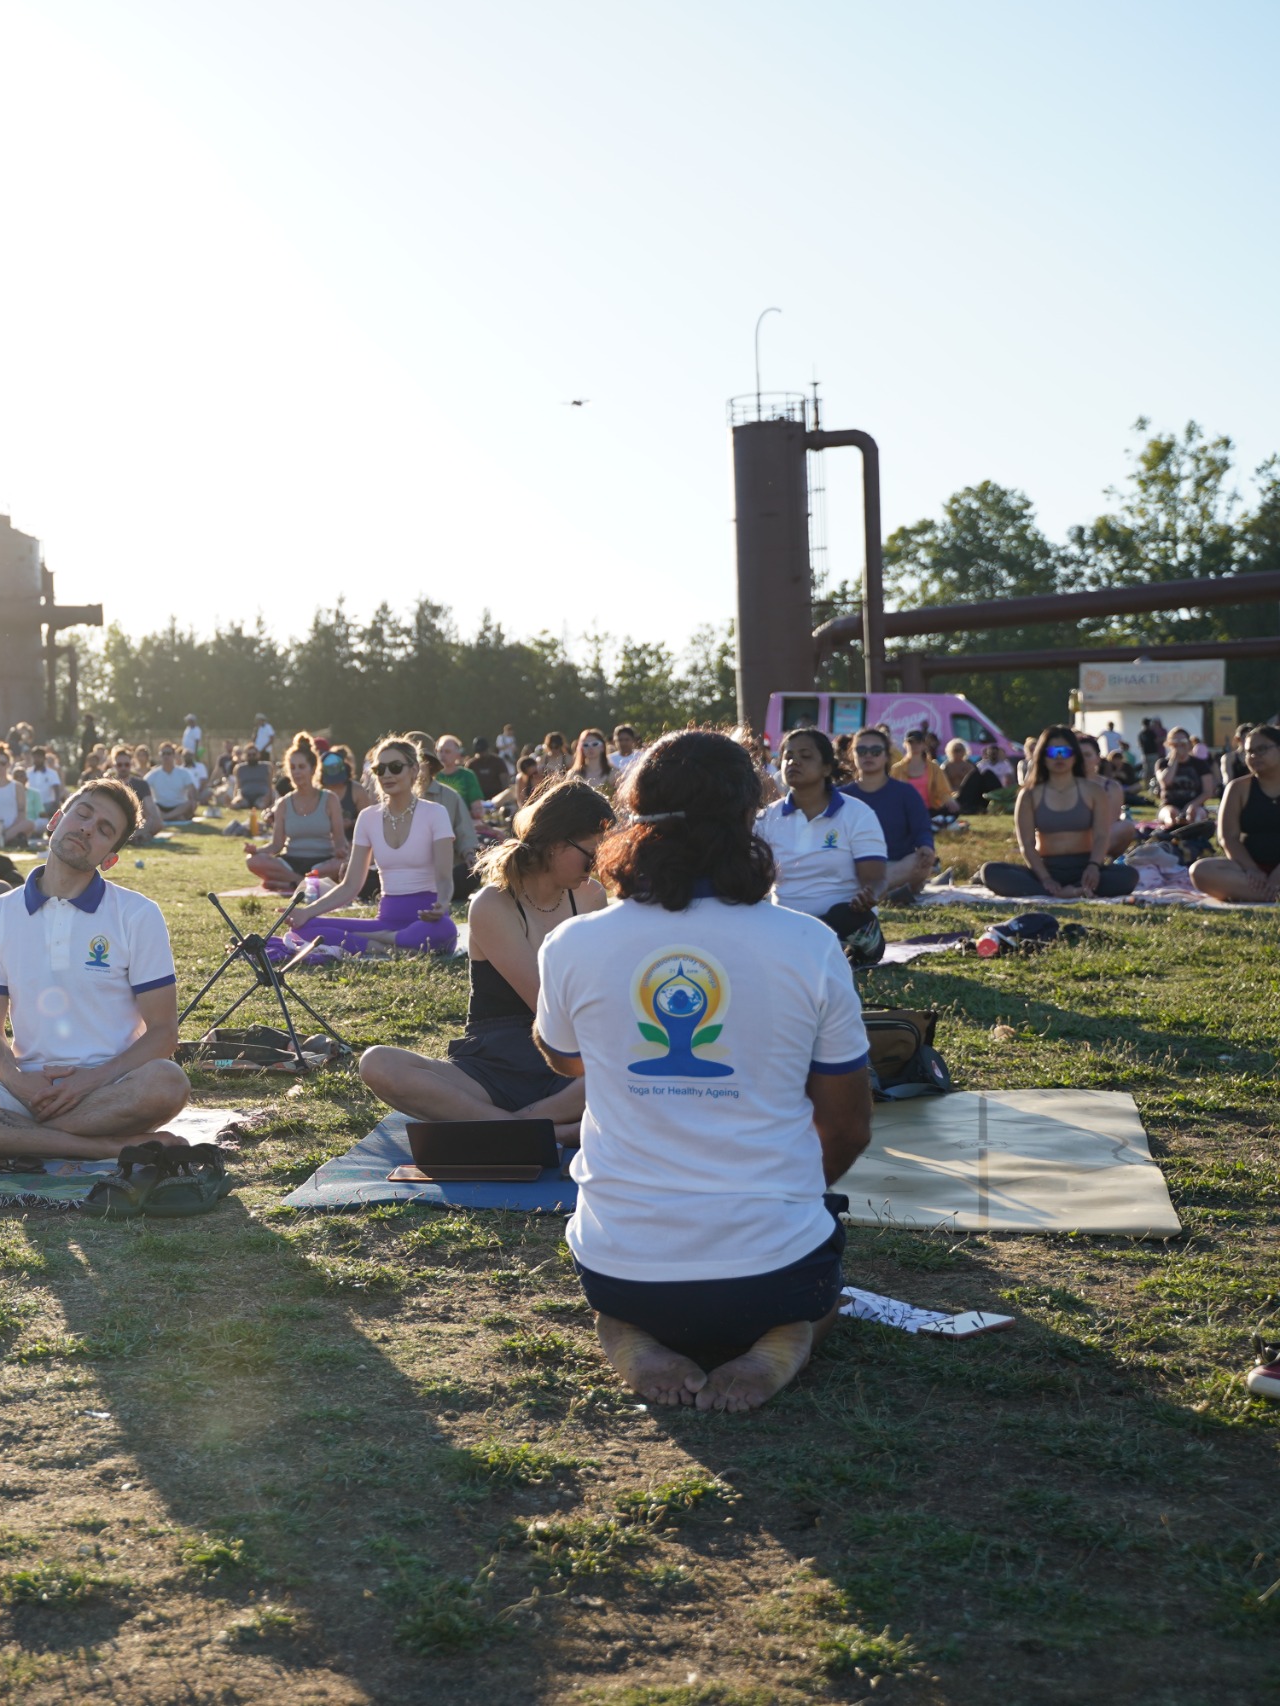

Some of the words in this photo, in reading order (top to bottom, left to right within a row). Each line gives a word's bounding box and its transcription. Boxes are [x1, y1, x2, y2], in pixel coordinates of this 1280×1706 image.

[1108, 673, 1160, 686] BHAKTI
[1162, 671, 1219, 685] STUDIO
[643, 956, 680, 987] International
[682, 955, 698, 966] Day
[707, 969, 718, 989] Yoga
[627, 1085, 650, 1096] Yoga
[652, 1085, 665, 1095] for
[667, 1086, 704, 1097] Healthy
[705, 1087, 739, 1099] Ageing
